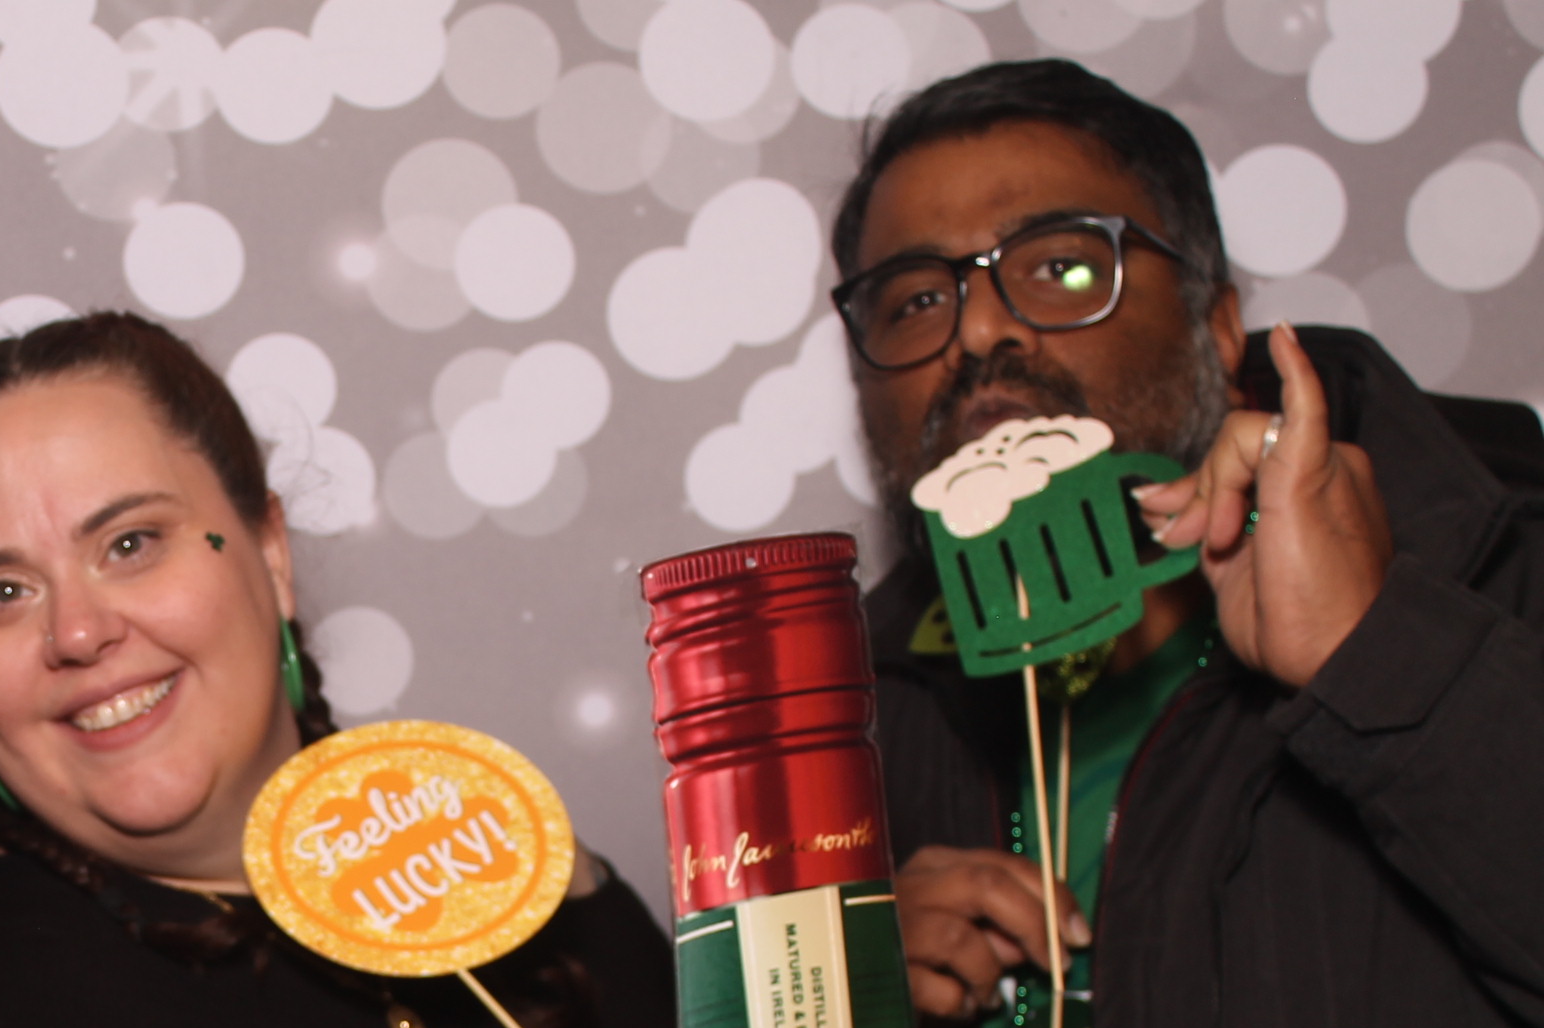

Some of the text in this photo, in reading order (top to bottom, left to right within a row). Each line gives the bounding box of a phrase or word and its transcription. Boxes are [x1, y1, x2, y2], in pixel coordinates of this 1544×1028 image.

[294, 775, 464, 877] Feeling
[352, 810, 518, 931] LUCKY!
[769, 967, 780, 986] IN
[785, 923, 804, 1005] MATURED
[795, 1010, 806, 1022] &
